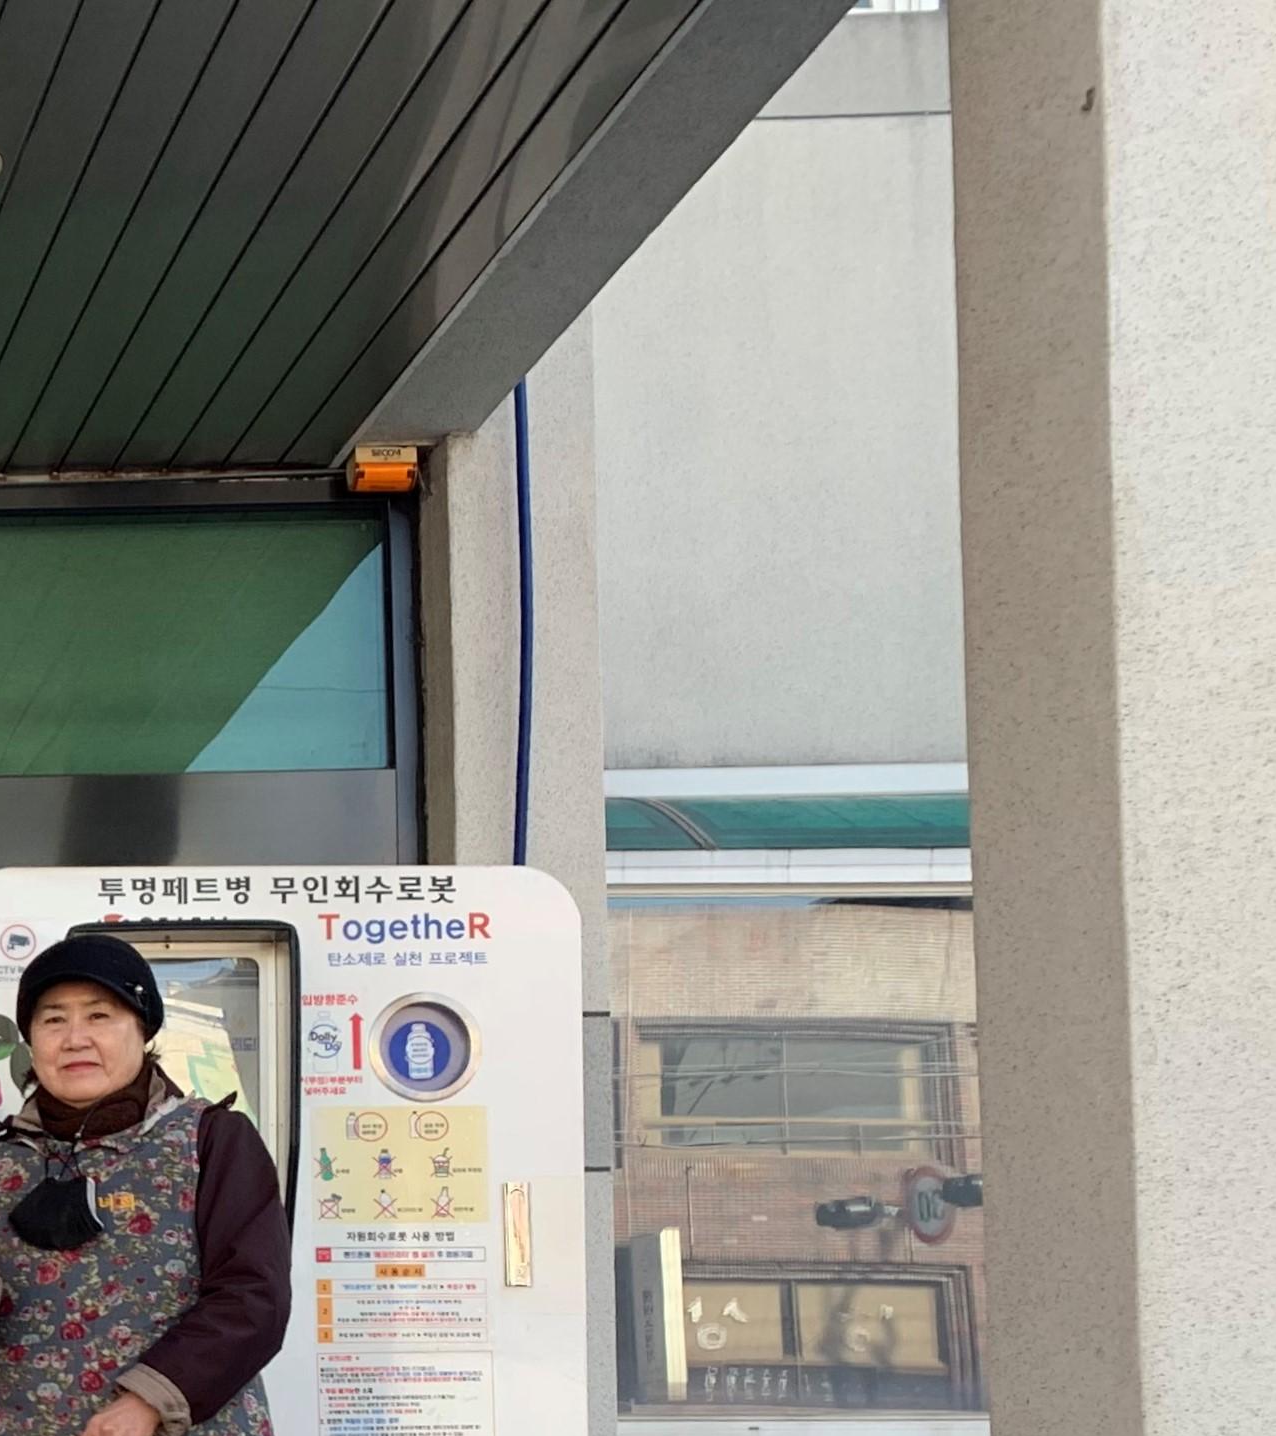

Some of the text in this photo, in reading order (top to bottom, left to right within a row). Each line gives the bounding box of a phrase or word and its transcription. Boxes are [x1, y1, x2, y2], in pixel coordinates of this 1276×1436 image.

[97, 873, 457, 905] 투명페트병 무인회수로봇
[317, 911, 492, 946] TogetheR
[327, 950, 488, 967] 탄소제로 실천 프로젝트
